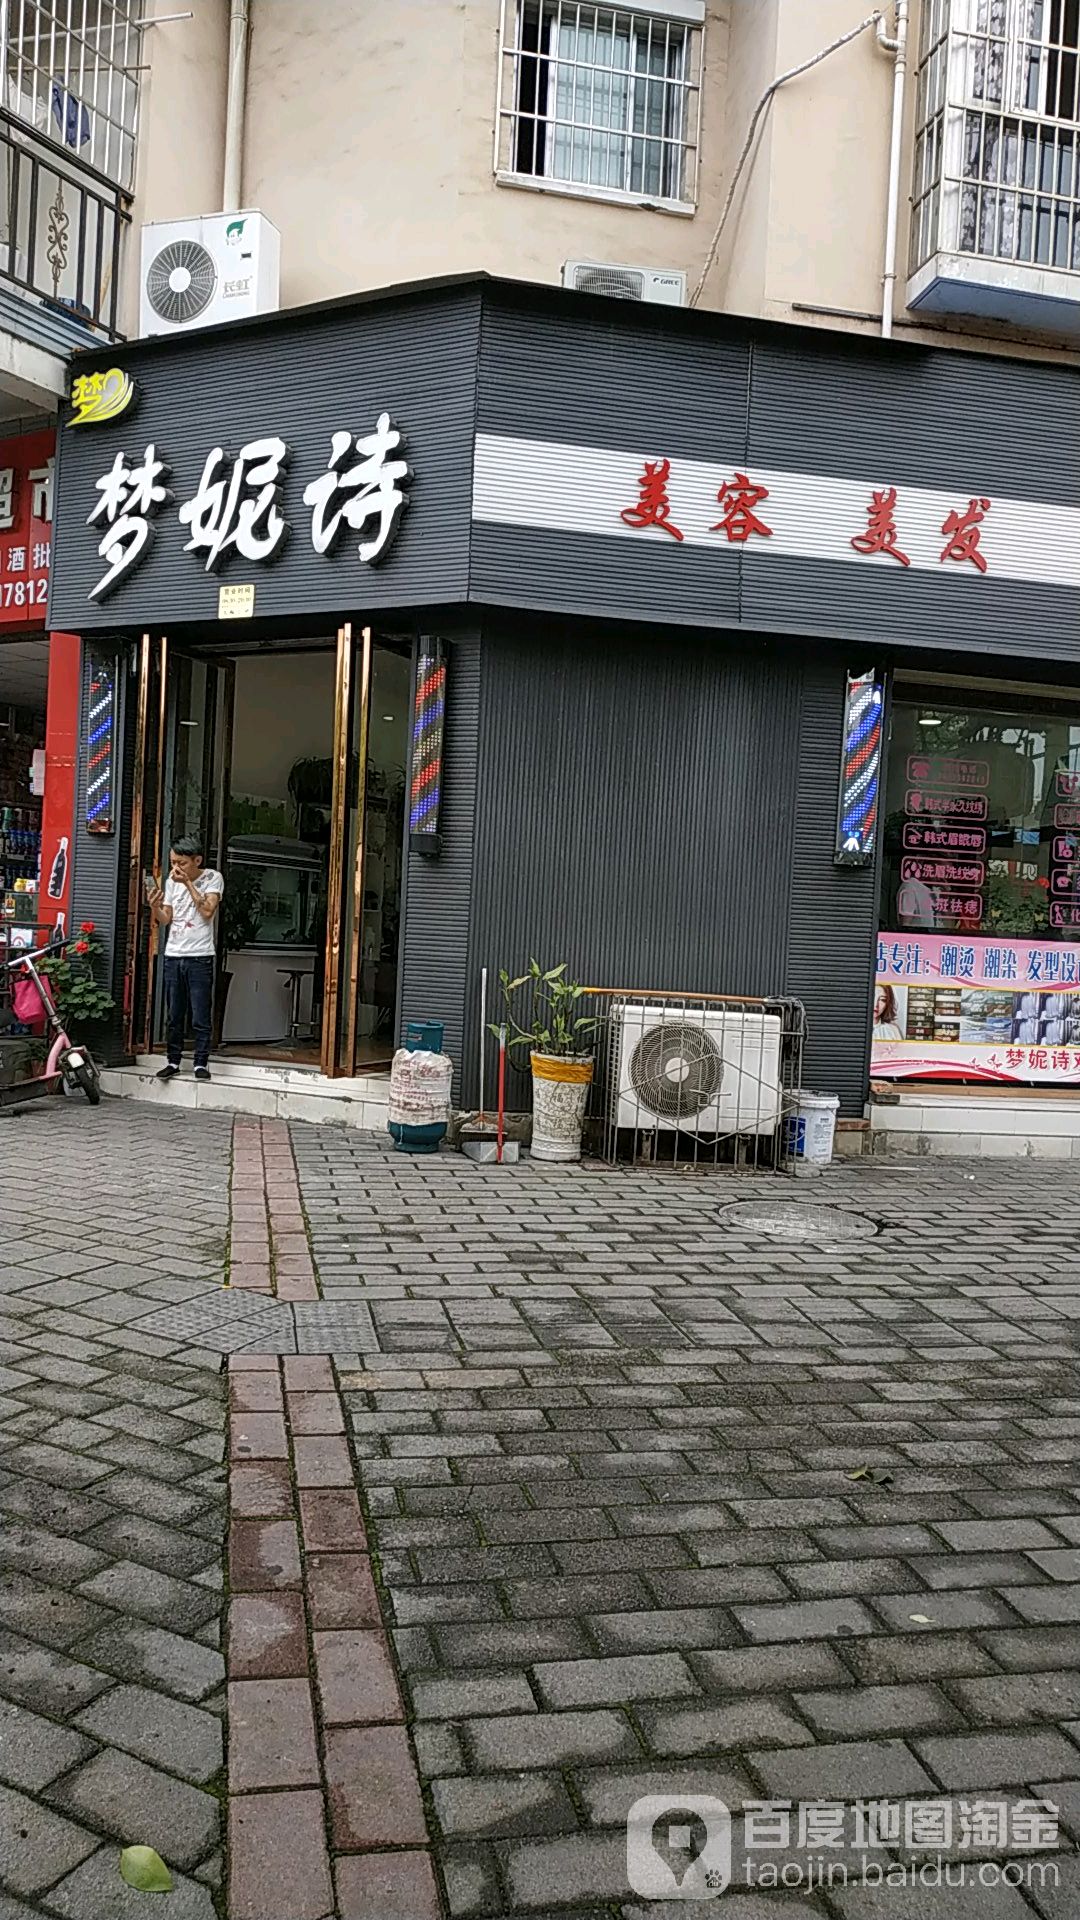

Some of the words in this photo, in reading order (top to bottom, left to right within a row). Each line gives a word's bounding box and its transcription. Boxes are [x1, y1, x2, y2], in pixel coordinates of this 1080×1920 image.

[224, 279, 250, 293] 长虹
[86, 412, 411, 600] 梦妮诗
[620, 458, 774, 542] 美容
[850, 487, 991, 573] 美发
[0, 541, 51, 573] 酒批
[924, 831, 983, 848] 韩式眉眼唇
[941, 945, 974, 977] 潮烫
[984, 947, 1017, 979] 潮染
[1027, 950, 1080, 982] 发型设
